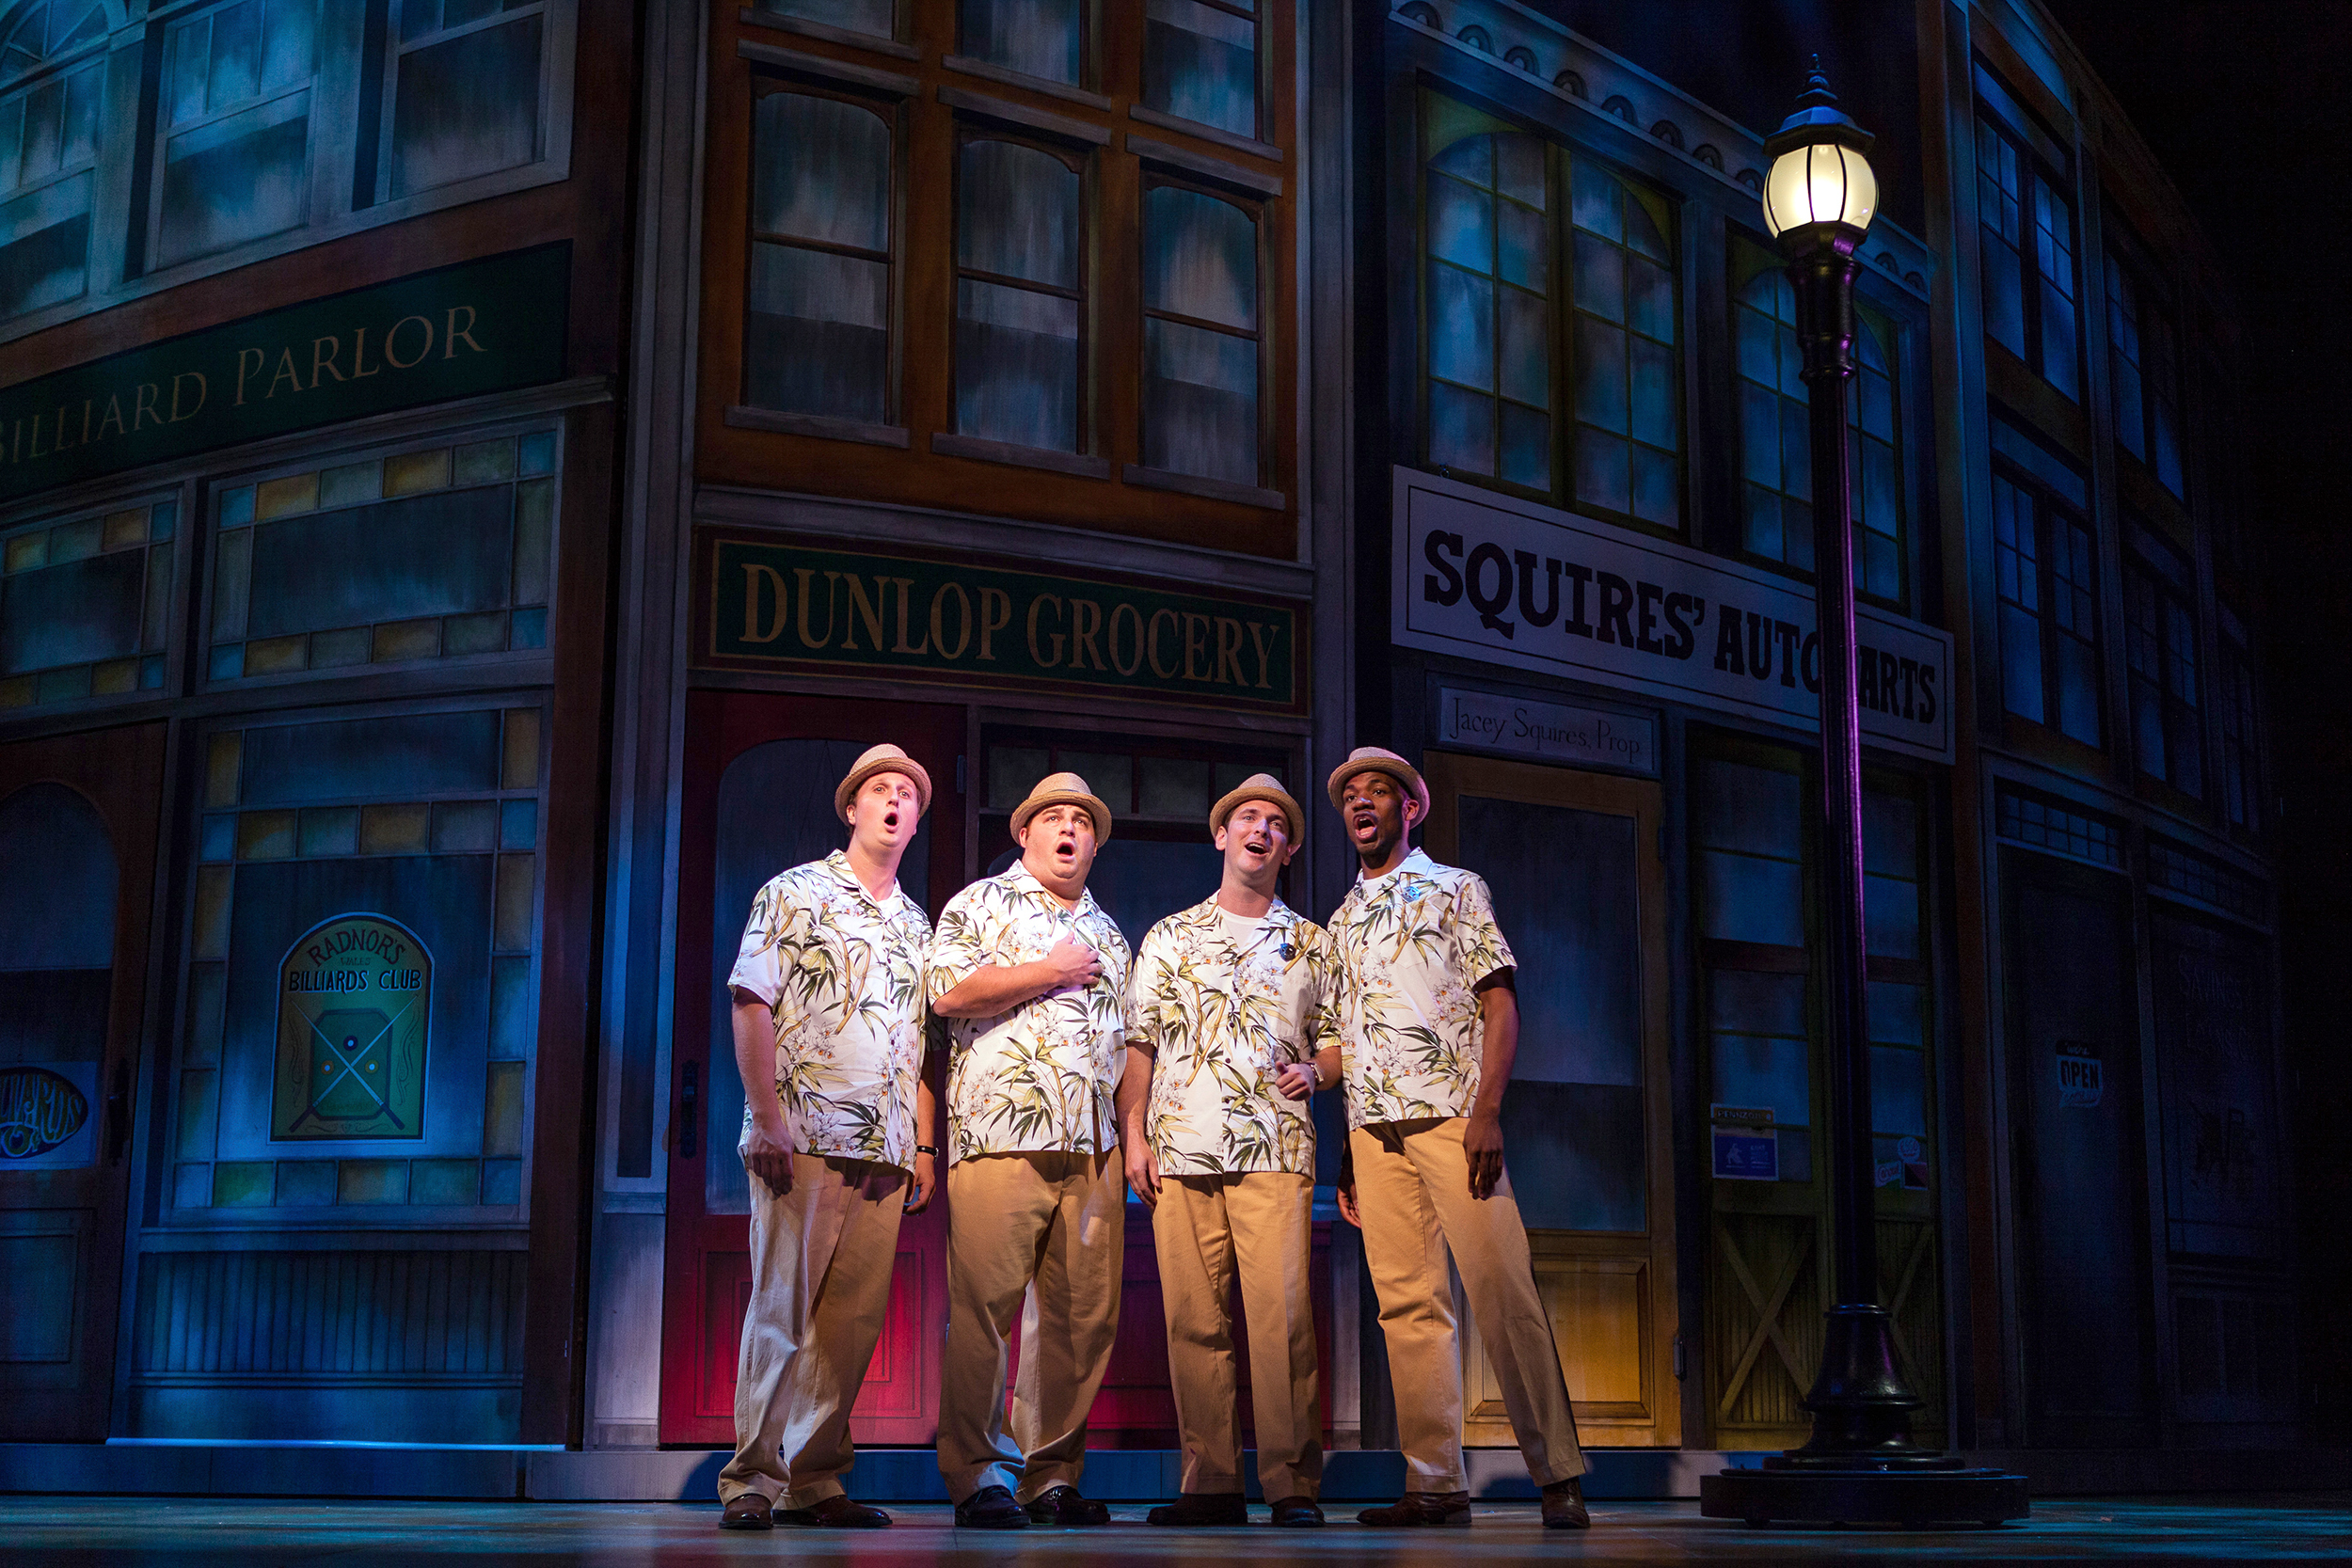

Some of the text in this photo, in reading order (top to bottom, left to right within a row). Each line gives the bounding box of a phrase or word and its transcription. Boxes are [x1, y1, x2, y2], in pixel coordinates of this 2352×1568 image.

[0, 306, 488, 464] ILLIARD PARLOR
[739, 563, 1280, 689] DUNLOP GROCERY
[1423, 530, 1936, 724] SQUIRES' AUTO ARTS
[1450, 698, 1505, 744] Jacey
[1515, 708, 1592, 751] Squires,
[307, 928, 405, 967] RADNOR'S
[289, 969, 422, 993] BILLIARDS CLUB
[2060, 1060, 2099, 1089] OPEN
